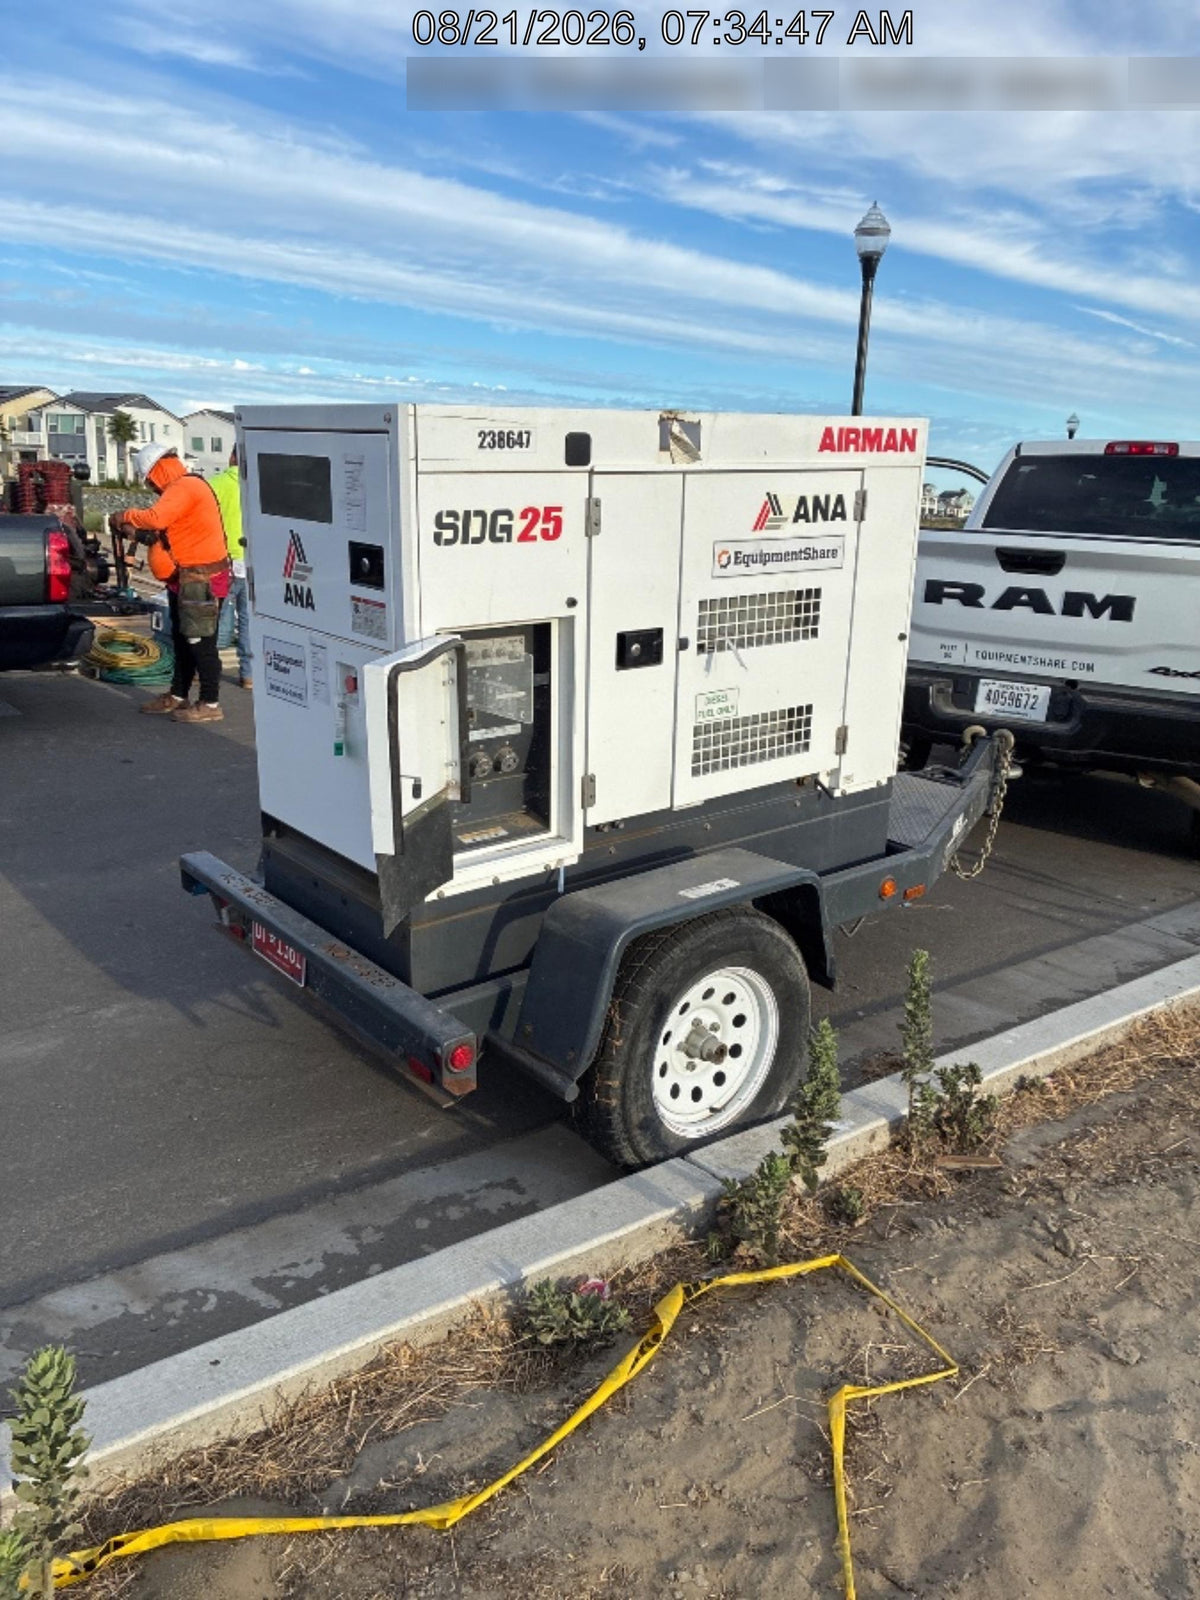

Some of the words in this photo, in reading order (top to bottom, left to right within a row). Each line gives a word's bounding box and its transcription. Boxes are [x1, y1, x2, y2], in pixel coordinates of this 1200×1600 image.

[477, 430, 532, 450] 238647
[818, 426, 918, 453] AIRMAN
[792, 494, 847, 524] ANA
[733, 547, 839, 569] EquipmentShare
[283, 582, 316, 611] ANA
[923, 578, 1137, 623] RAM
[975, 649, 1095, 673] EQUIPMENTSHARECOM
